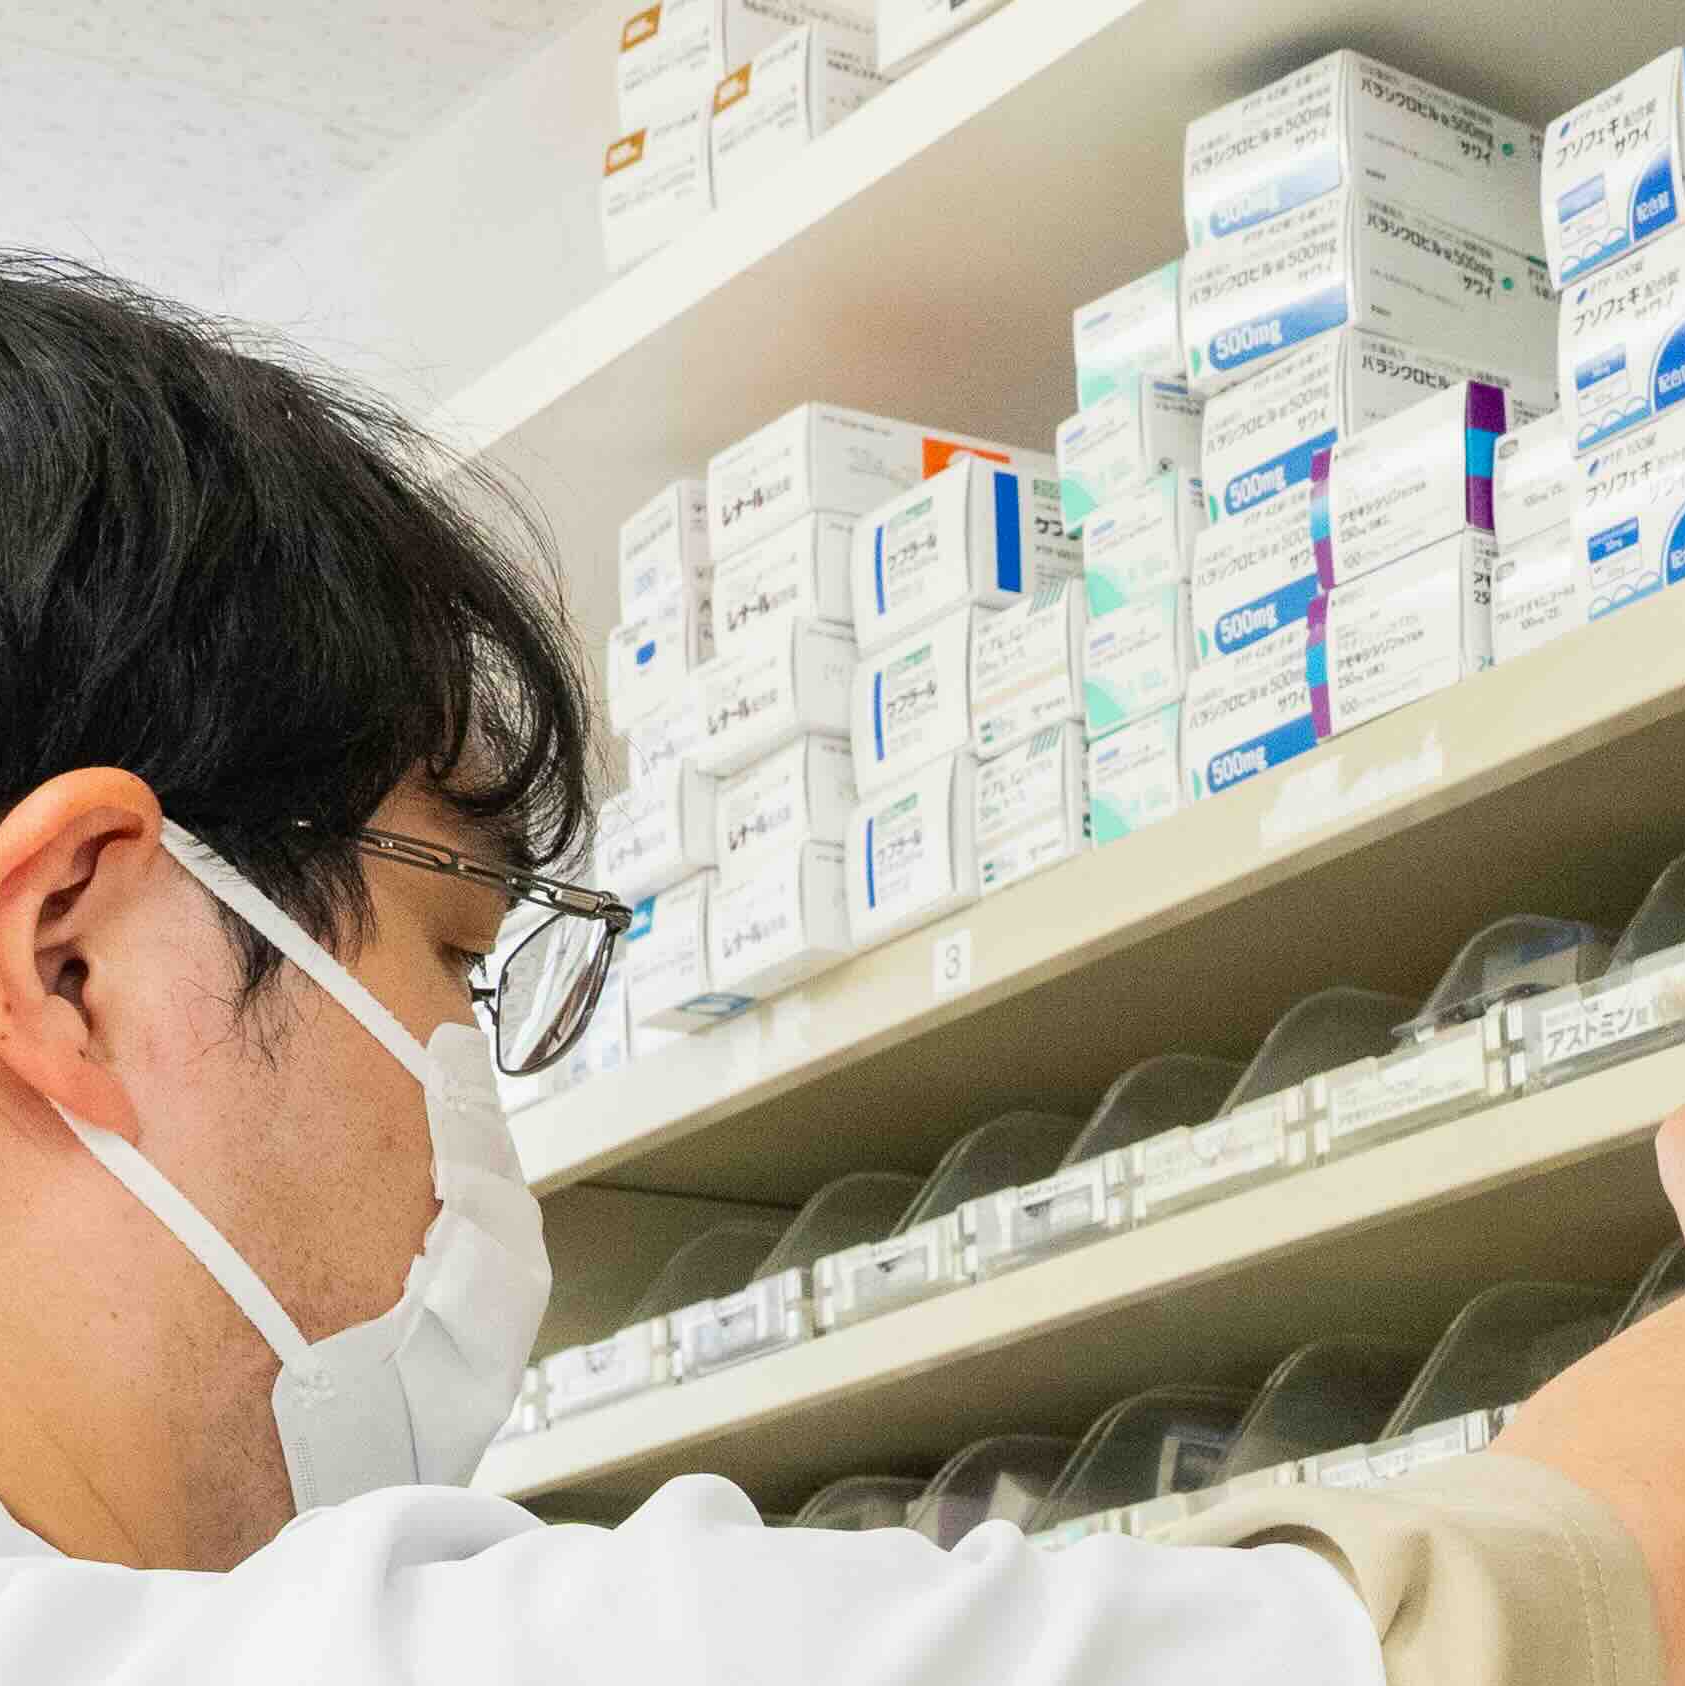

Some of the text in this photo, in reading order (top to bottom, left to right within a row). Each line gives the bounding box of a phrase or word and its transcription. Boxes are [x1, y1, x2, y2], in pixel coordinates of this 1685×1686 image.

[1215, 319, 1283, 362] 500mg
[1229, 465, 1286, 509] 500mg
[1218, 603, 1278, 644] 500mg
[1211, 747, 1268, 785] 500mg
[945, 944, 962, 981] 3
